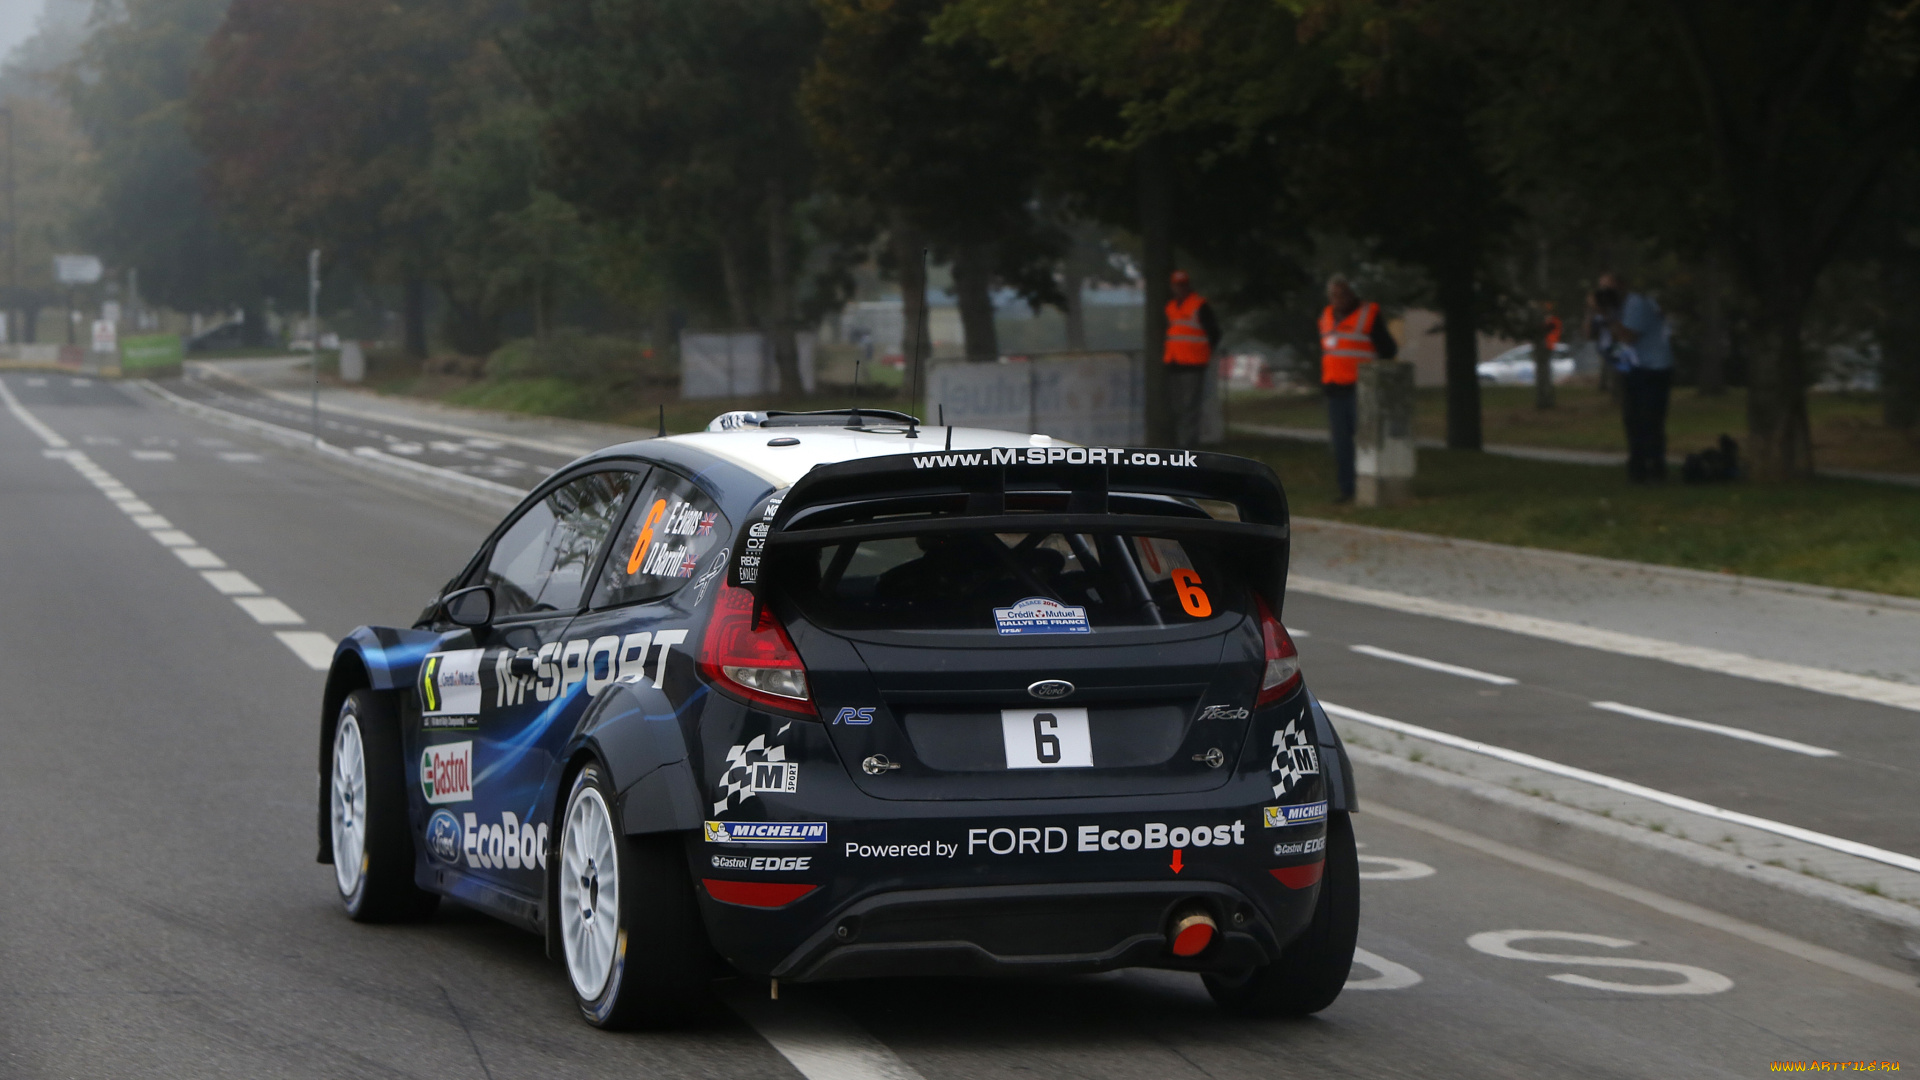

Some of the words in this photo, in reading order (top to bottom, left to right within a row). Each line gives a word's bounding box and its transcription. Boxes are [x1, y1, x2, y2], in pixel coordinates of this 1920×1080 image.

[912, 447, 1198, 469] www.M-SPORT.co.uk
[664, 501, 682, 534] E
[671, 502, 703, 536] Evans
[626, 498, 667, 575] 6
[650, 542, 688, 578] Barritt
[1018, 600, 1041, 609] ALSACE
[1042, 600, 1058, 608] 2014
[1170, 567, 1212, 618] 6
[1007, 610, 1035, 619] Crédit
[1045, 610, 1076, 618] Mutuel
[494, 629, 690, 708] M-SPORT
[832, 706, 877, 725] RS
[1032, 712, 1062, 764] 6
[433, 750, 470, 796] Castrol
[1293, 748, 1315, 771] M
[755, 764, 784, 789] M
[787, 764, 797, 791] SPORT
[432, 817, 457, 858] Ford
[732, 824, 824, 837] MICHELIN
[845, 840, 931, 858] Powered
[935, 840, 958, 858] by
[968, 826, 1068, 856] FORD
[1077, 819, 1246, 852] EcoBoost
[719, 857, 748, 868] Castrol
[750, 856, 813, 871] EDGE
[1281, 842, 1304, 854] Castrol
